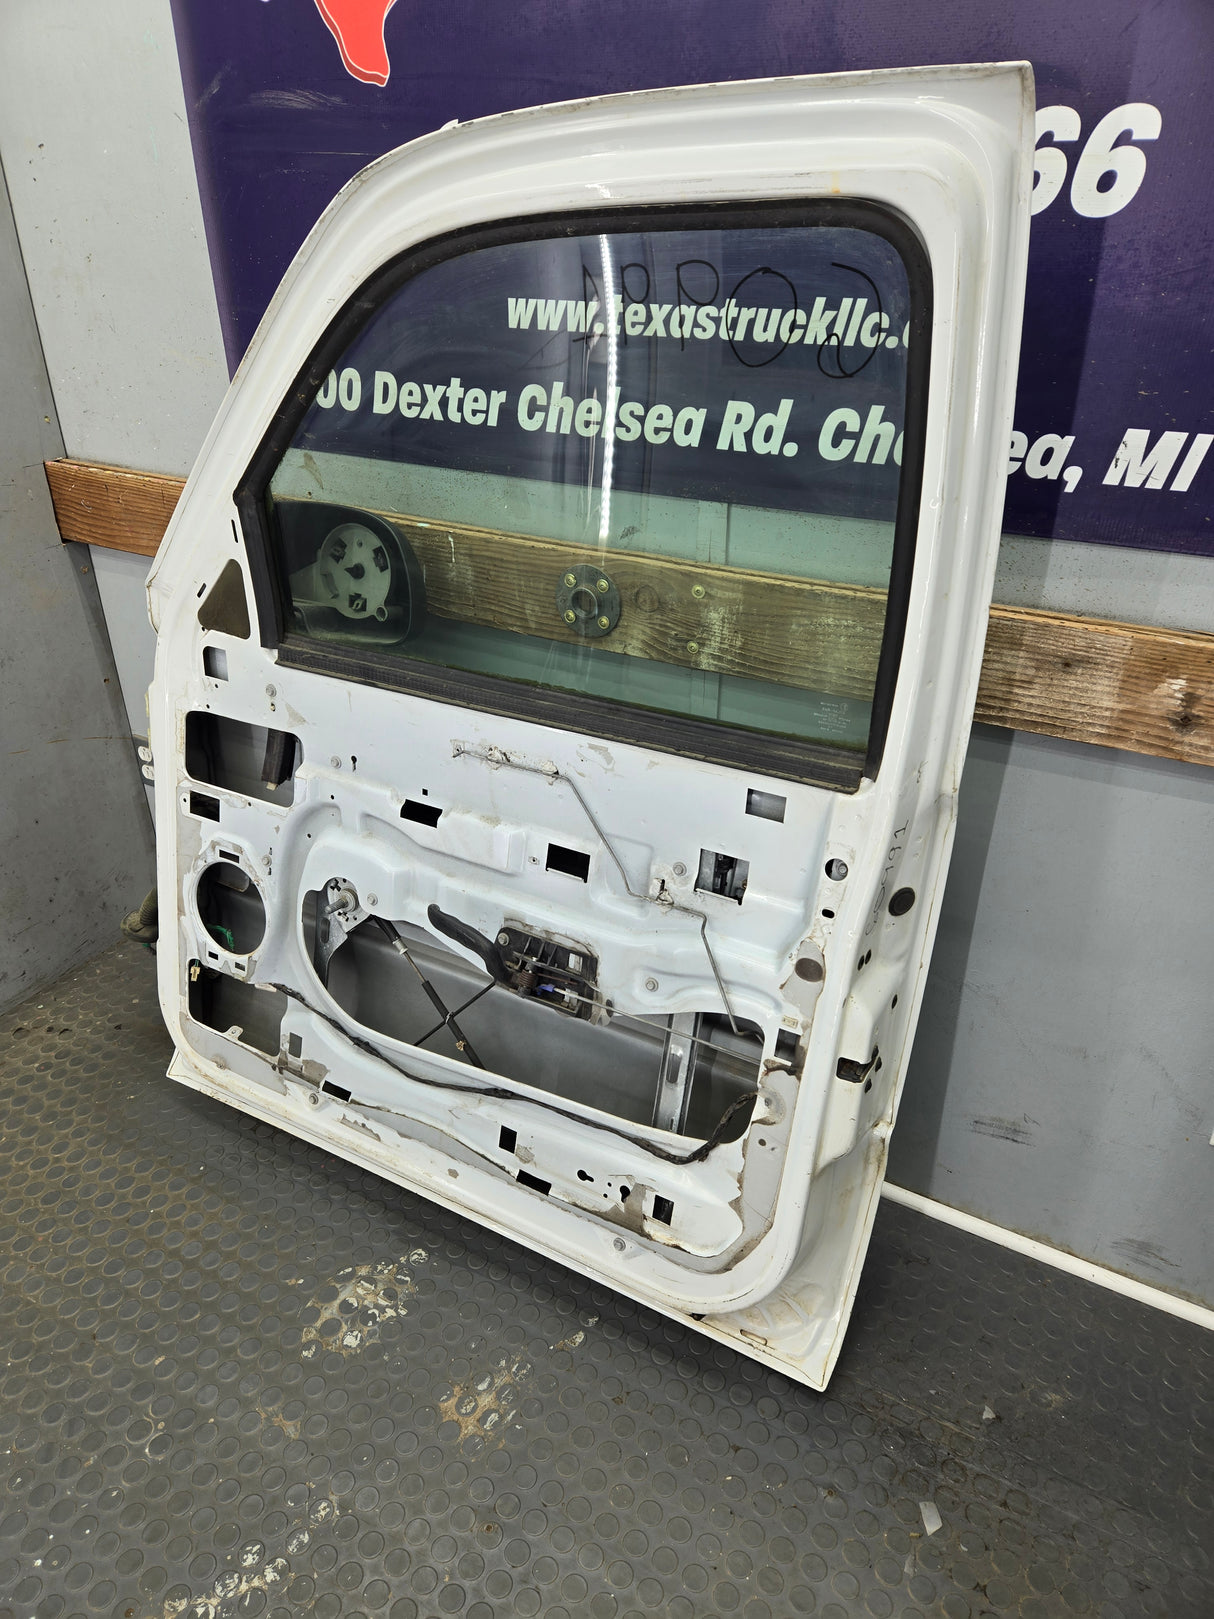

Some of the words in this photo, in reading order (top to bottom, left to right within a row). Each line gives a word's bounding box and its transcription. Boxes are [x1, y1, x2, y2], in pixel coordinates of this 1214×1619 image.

[507, 294, 910, 350] www.texastruckllc.
[372, 370, 507, 428] Dexter
[715, 398, 799, 458] Rd.
[818, 404, 905, 467] Ch
[1102, 428, 1214, 492] MI
